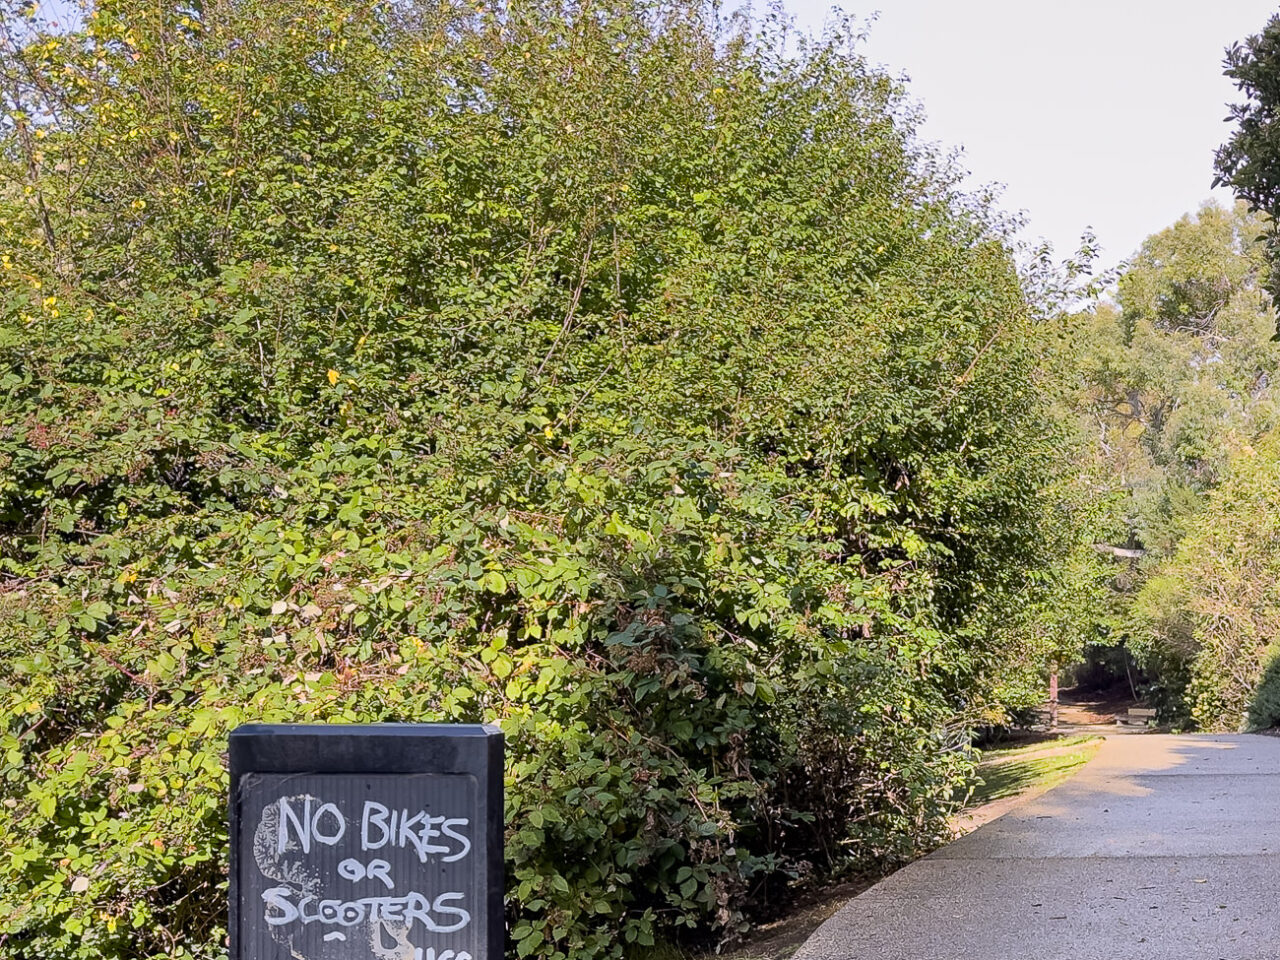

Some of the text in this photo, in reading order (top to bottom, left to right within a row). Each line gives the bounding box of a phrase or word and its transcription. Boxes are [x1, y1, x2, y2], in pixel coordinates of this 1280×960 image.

[278, 794, 471, 863] NO BIKES
[337, 857, 394, 889] OR
[261, 887, 471, 933] SCOOTERS
